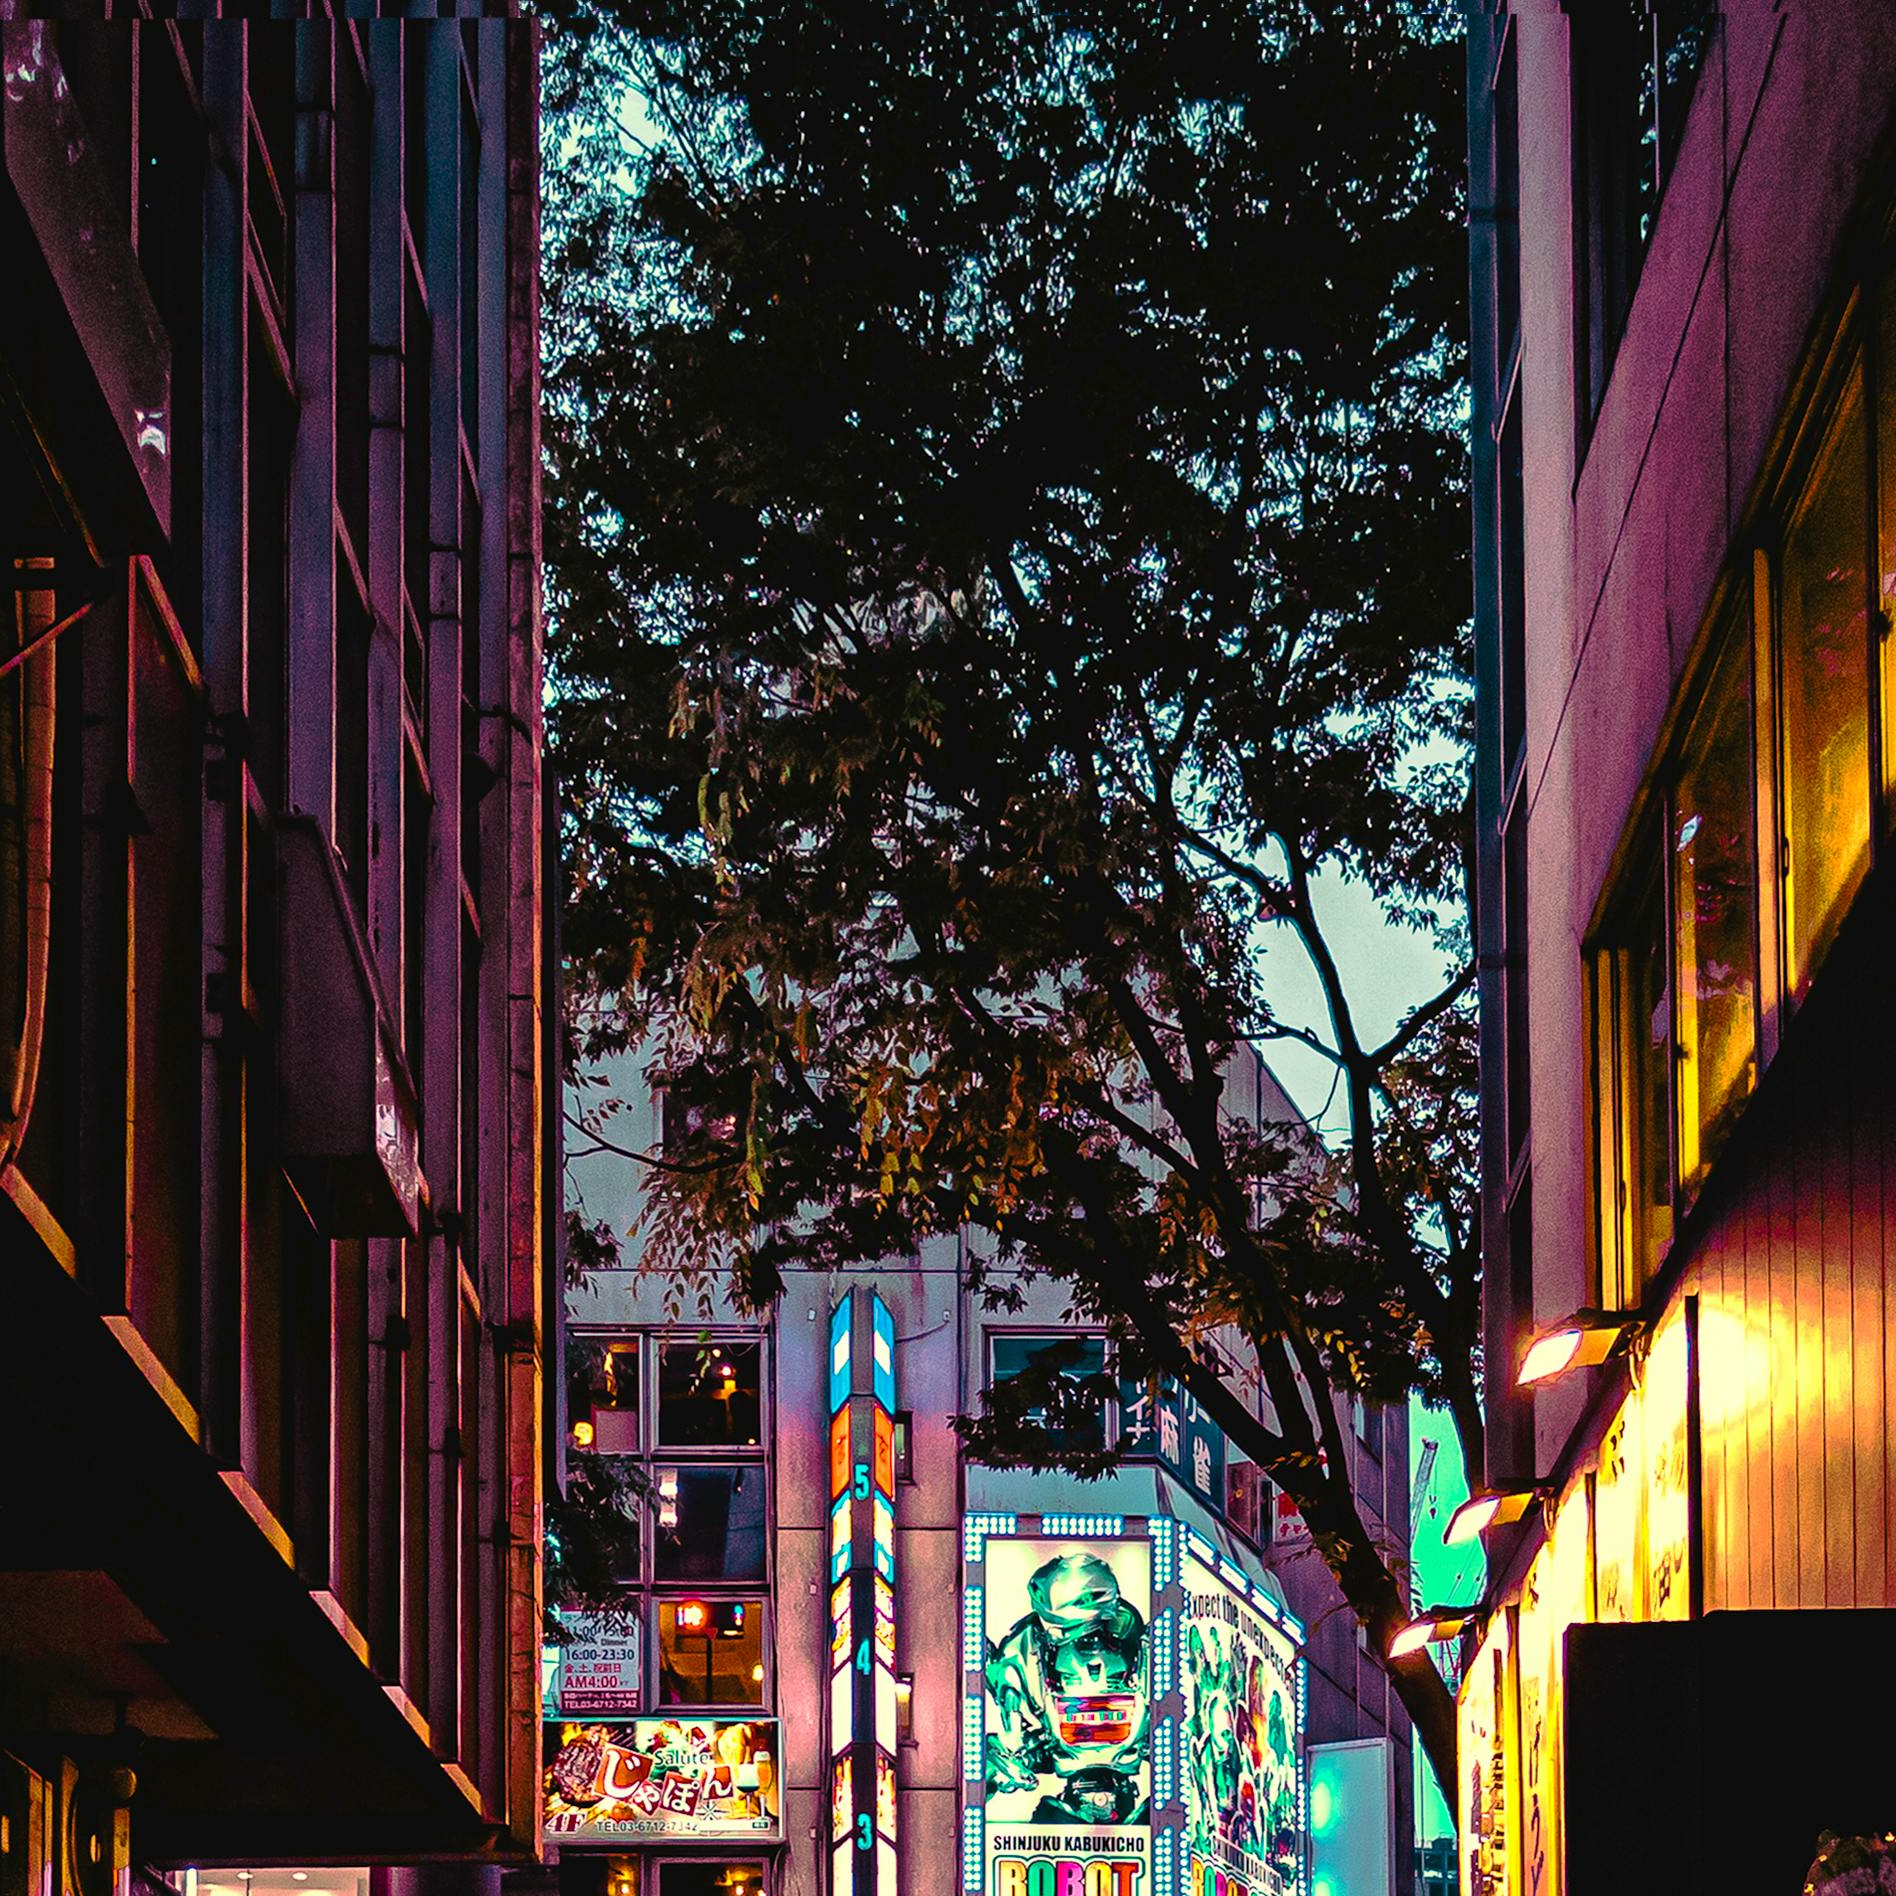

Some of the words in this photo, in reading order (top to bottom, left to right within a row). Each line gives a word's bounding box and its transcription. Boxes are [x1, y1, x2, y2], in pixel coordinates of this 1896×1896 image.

[854, 1463, 870, 1500] 5
[565, 1648, 635, 1661] 16:00-23:30
[856, 1638, 871, 1676] 4
[564, 1675, 619, 1688] AM4:00
[654, 1750, 710, 1766] Salute
[545, 1812, 588, 1834] 4F
[856, 1812, 873, 1851] 3
[993, 1835, 1061, 1851] SHINJUKU
[1064, 1836, 1145, 1852] KABUKICHO
